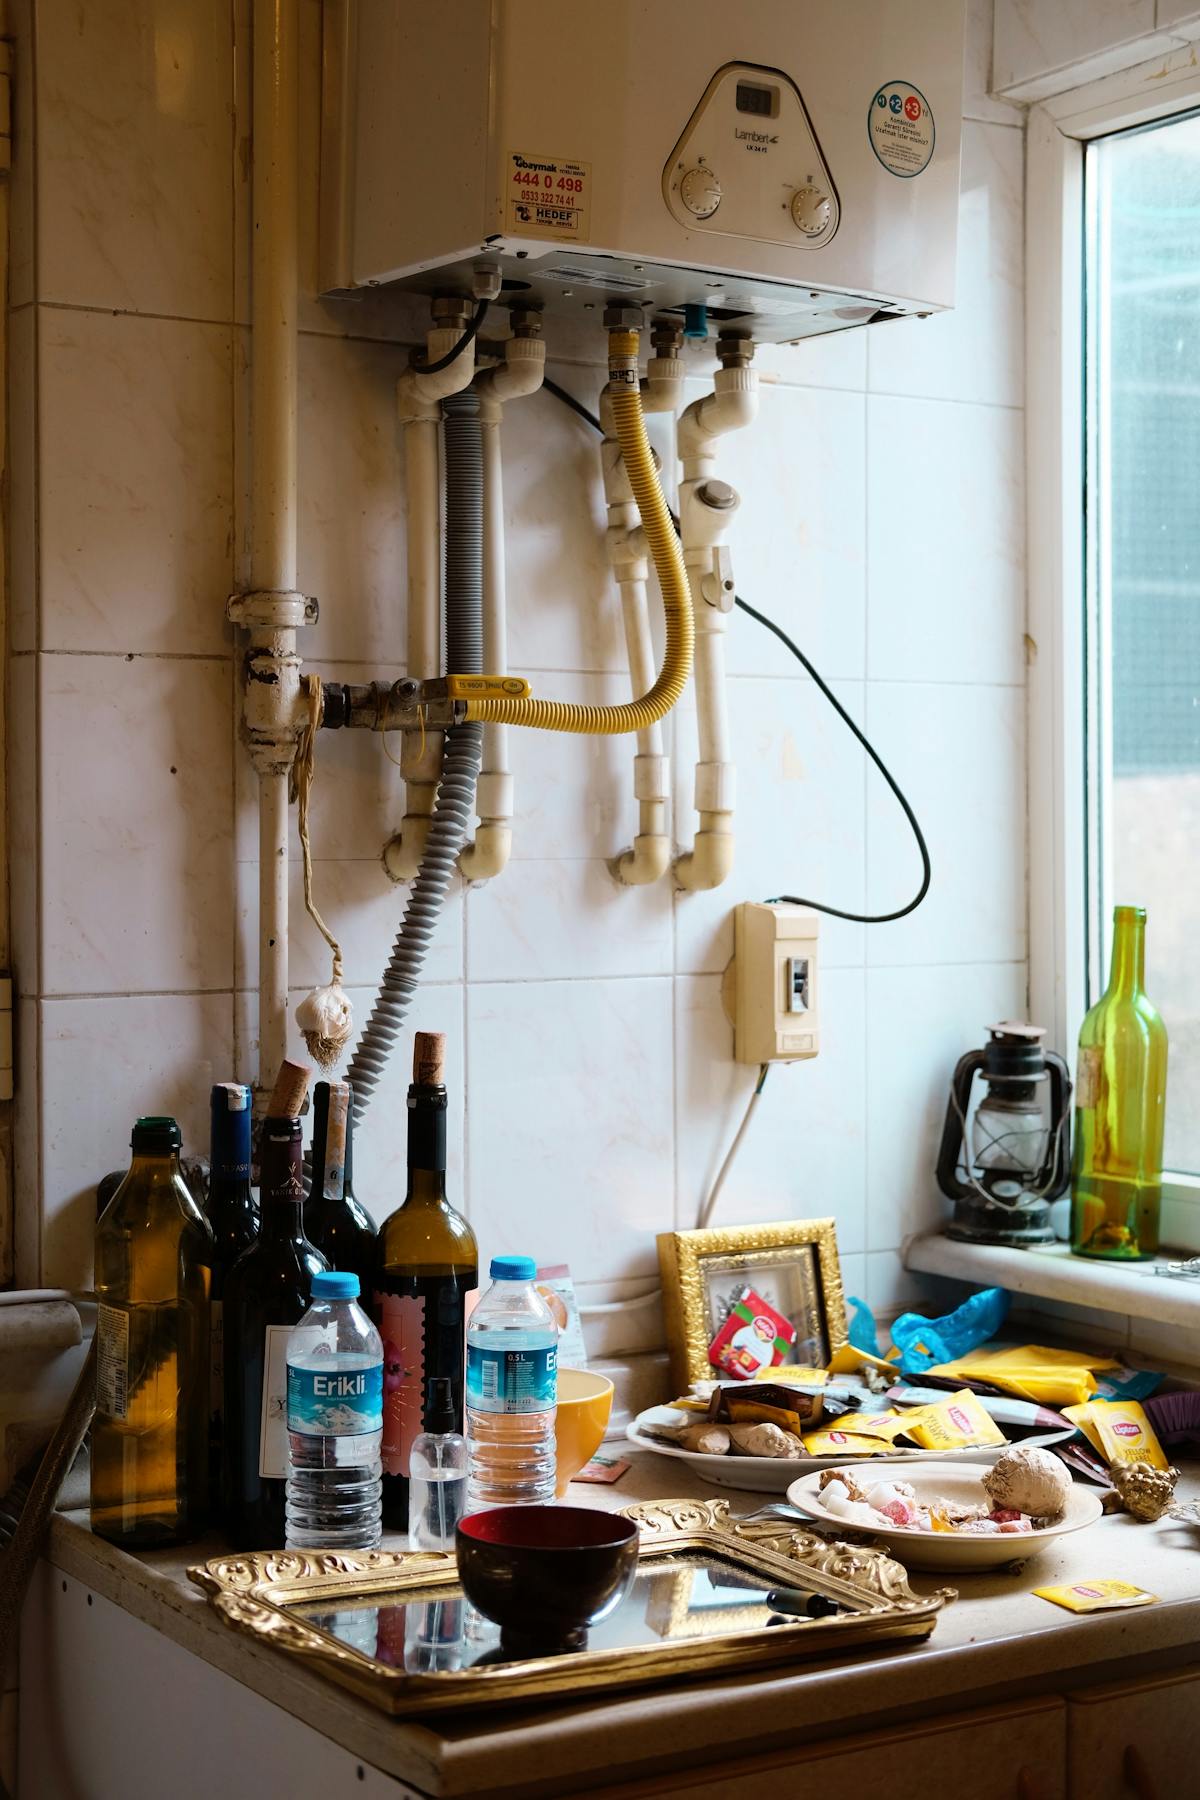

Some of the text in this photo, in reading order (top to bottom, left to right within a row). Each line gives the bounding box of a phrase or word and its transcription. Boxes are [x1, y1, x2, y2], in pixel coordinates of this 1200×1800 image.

[905, 102, 920, 116] +3
[735, 128, 769, 144] Lambert
[513, 171, 583, 192] 444 0 498
[521, 190, 539, 201] 0533
[541, 192, 554, 204] 322
[555, 194, 564, 206] 74
[536, 208, 573, 221] HEDEF
[507, 1354, 520, 1362] 0,5
[313, 1374, 366, 1397] Erikli
[1113, 1425, 1140, 1435] Lipton
